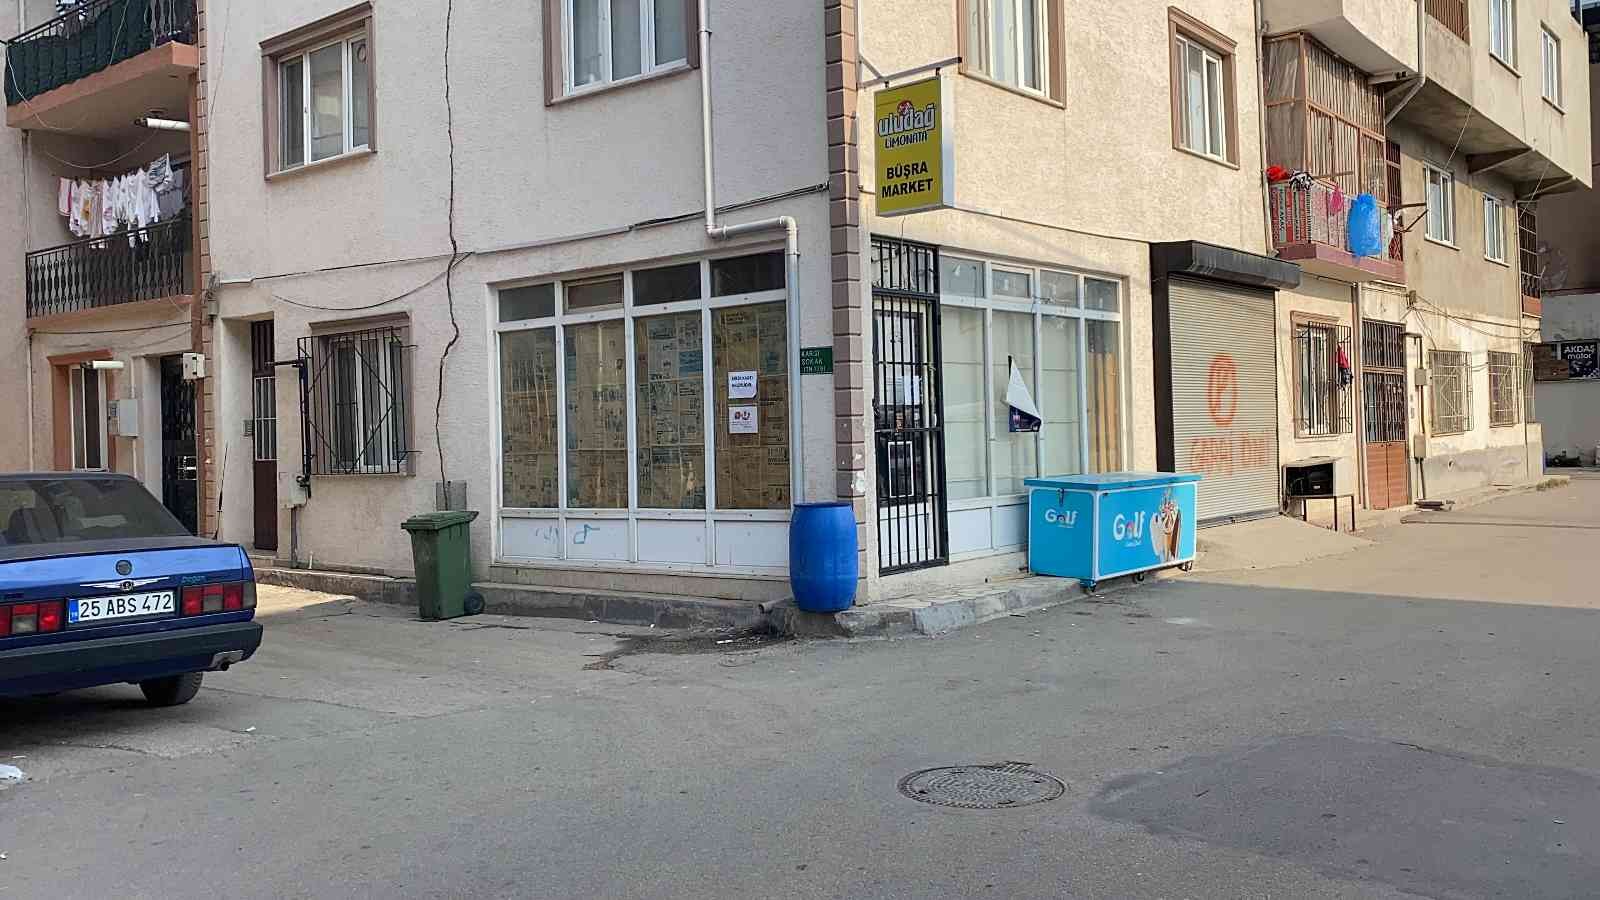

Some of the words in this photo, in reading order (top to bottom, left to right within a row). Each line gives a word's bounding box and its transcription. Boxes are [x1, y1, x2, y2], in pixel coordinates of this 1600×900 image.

[878, 102, 936, 138] uludağ
[886, 161, 929, 180] BÜŞRA
[882, 178, 934, 199] MARKET
[80, 601, 101, 619] 25
[106, 597, 137, 616] ABS
[142, 593, 173, 612] 472
